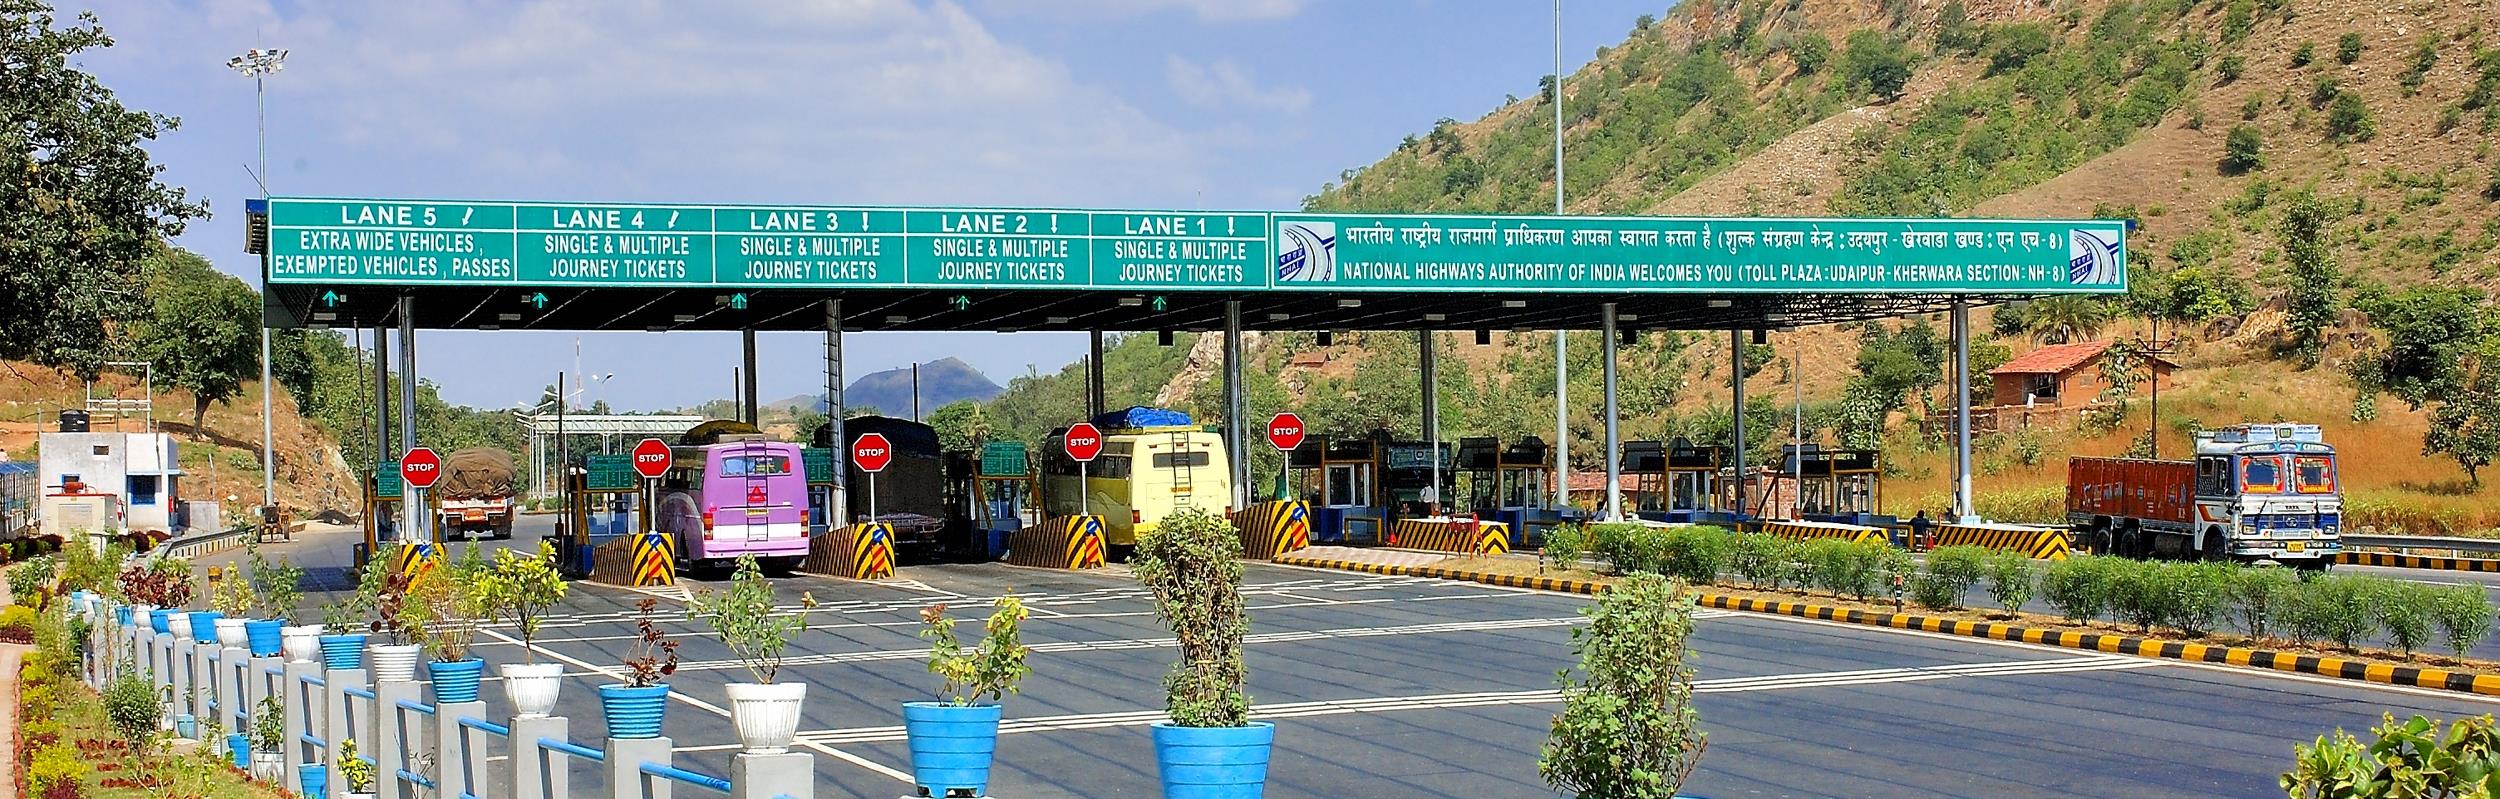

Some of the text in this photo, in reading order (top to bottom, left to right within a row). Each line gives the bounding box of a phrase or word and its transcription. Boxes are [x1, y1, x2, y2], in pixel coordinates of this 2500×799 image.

[342, 206, 437, 226] LANE 5
[553, 209, 645, 229] LANE 4
[751, 212, 839, 231] LANE 3
[942, 214, 1027, 233] LANE 2
[1124, 217, 1206, 235] LANE 1
[1345, 221, 1394, 245] भारतीय
[1448, 221, 1497, 245] राजमार्ग
[1503, 223, 1565, 247] प्राधिकरण
[1571, 229, 1612, 247] आपका
[1619, 230, 1659, 248] स्वागत
[1664, 230, 1697, 248] करता
[1702, 222, 1711, 250] है
[300, 231, 351, 250] EXTRA
[355, 232, 394, 251] WIDE
[545, 235, 689, 255] SINGLE & MULTIPLE
[740, 237, 880, 256] SINGLE & MULTIPLE
[933, 238, 1068, 258] SINGLE & MULTIPLE
[1114, 241, 1246, 260] SINGLE & MULTIPLE
[275, 255, 358, 274] EXEMPTED
[452, 258, 511, 277] PASSES
[549, 258, 686, 278] JOURNEY TICKETS
[744, 260, 877, 279] JOURNEY TICKETS
[938, 261, 1065, 281] JOURNEY TICKETS
[1119, 263, 1243, 283] JOURNEY TICKETS
[1343, 262, 1410, 280] NATIONAL
[1415, 262, 1484, 280] HIGHWAYS
[1488, 263, 1564, 281] AUTHORITY
[1568, 263, 1585, 281] OF
[1590, 264, 1625, 281] INDIA
[1629, 264, 1702, 282] WELCOMES
[1706, 264, 1732, 282] YOU
[1273, 427, 1299, 437] STOP
[1070, 437, 1096, 447] STOP
[638, 453, 665, 463] STOP
[858, 447, 884, 457] STOP
[407, 463, 434, 472] STOP
